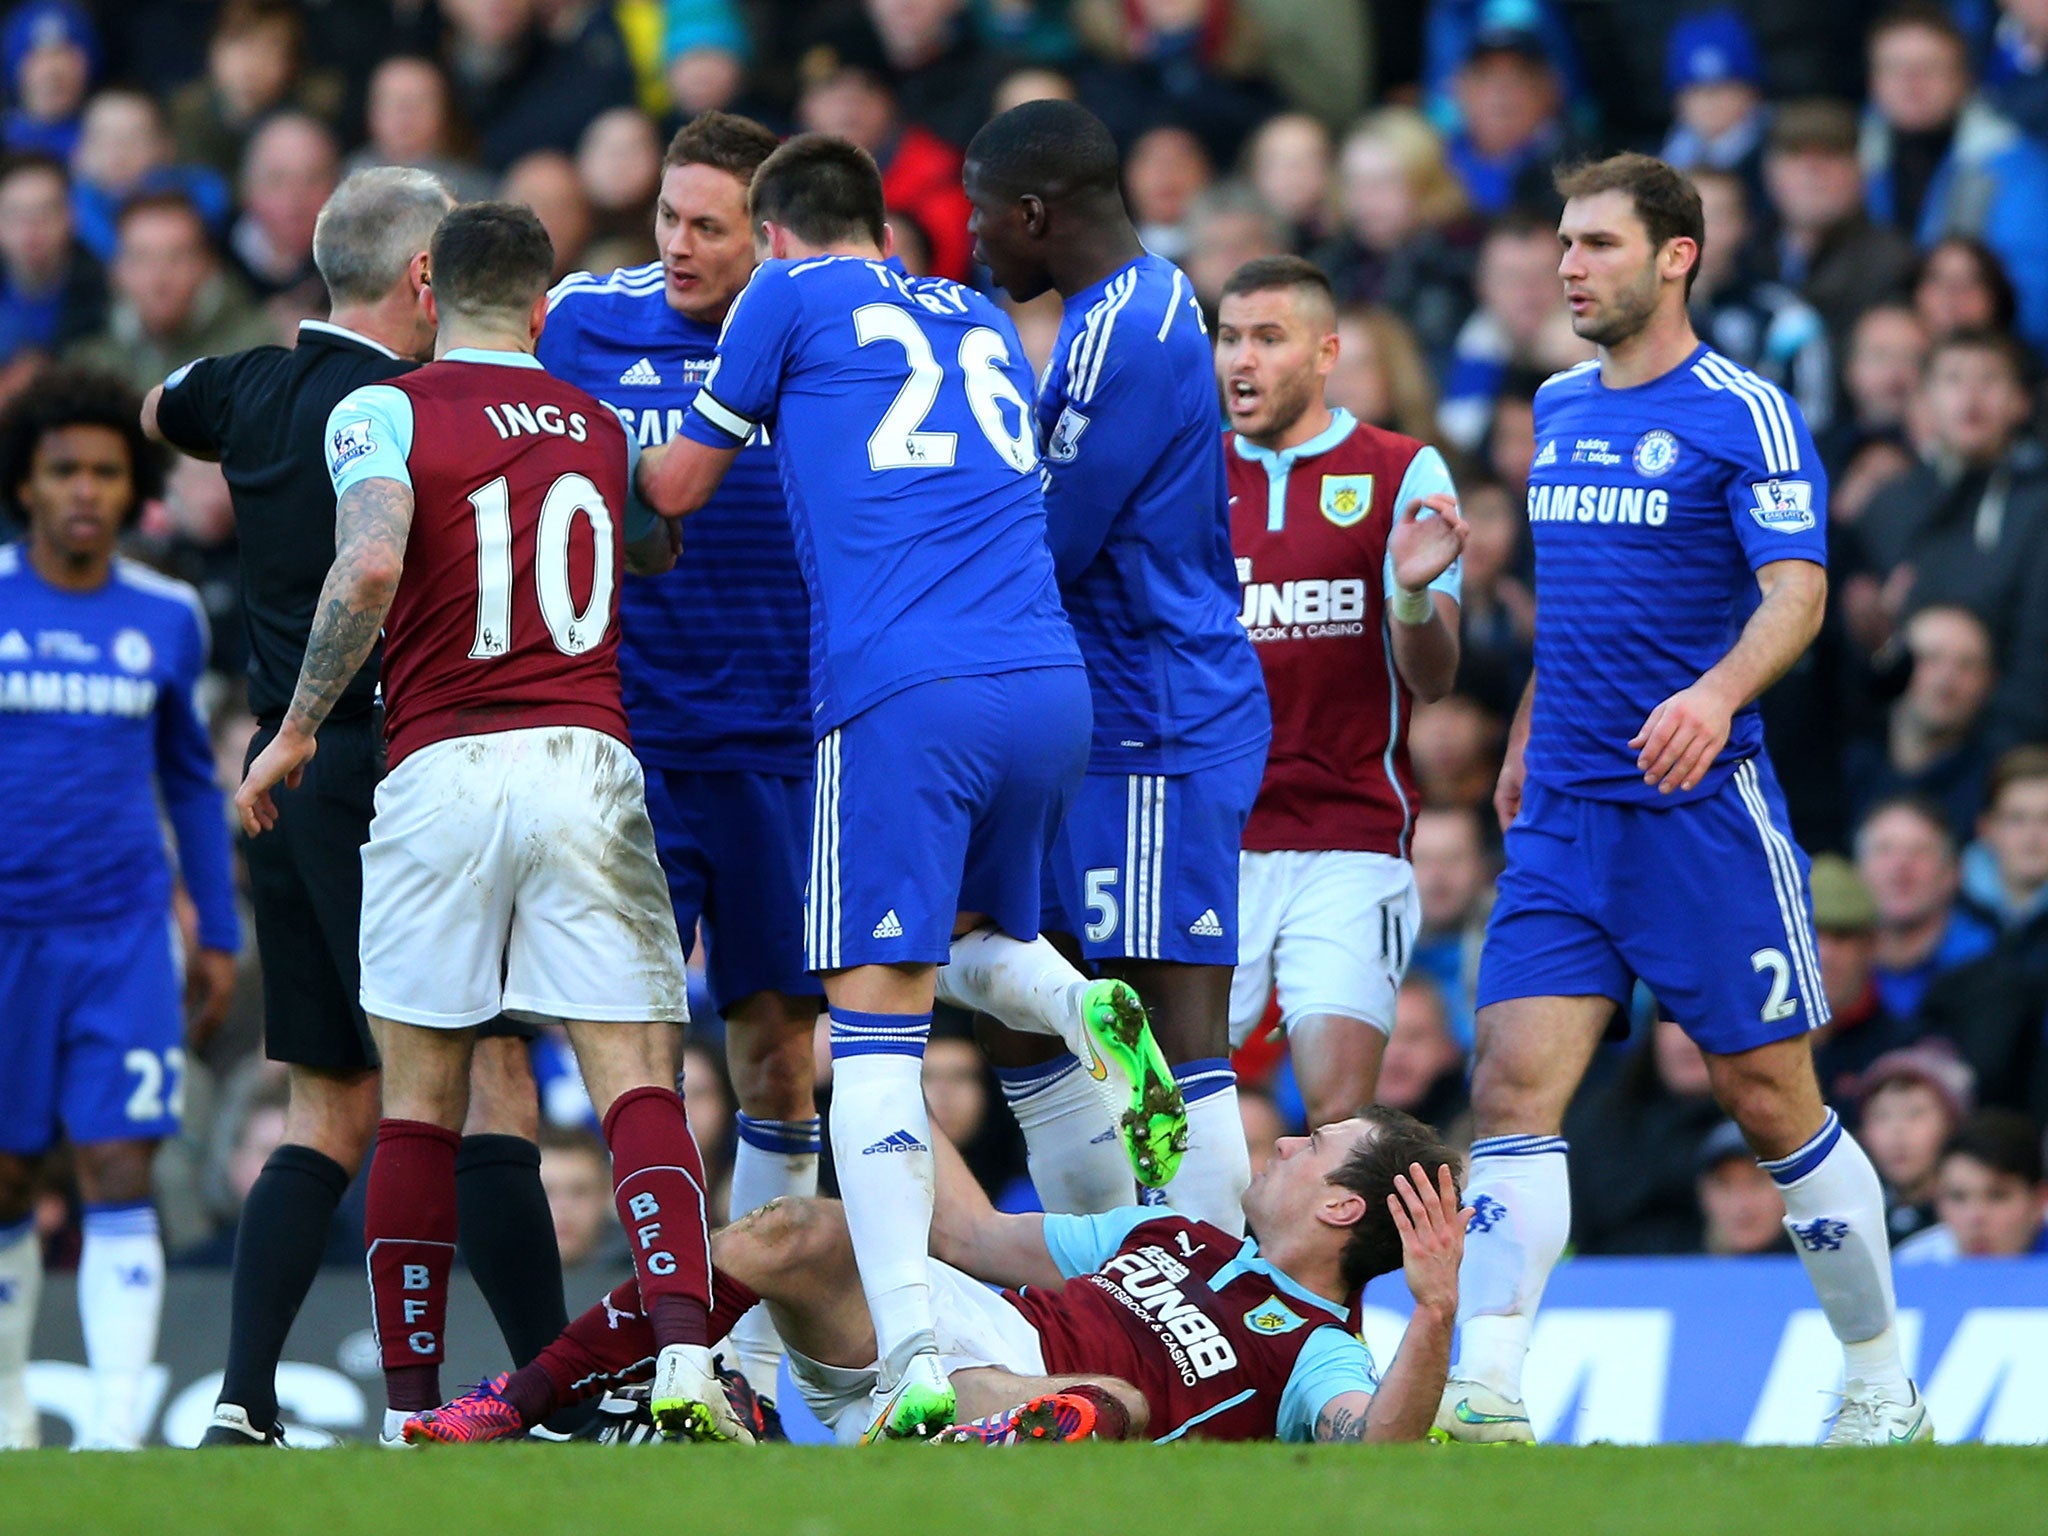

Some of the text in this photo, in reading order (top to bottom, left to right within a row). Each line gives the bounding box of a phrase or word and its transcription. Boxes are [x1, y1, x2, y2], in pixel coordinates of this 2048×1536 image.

[619, 374, 661, 385] adidas
[852, 302, 1038, 475] 26
[483, 402, 588, 442] INGS
[1528, 485, 1669, 526] SAMSUNG
[467, 472, 615, 659] 10
[1306, 622, 1363, 637] CASINO
[1084, 867, 1119, 943] 5
[872, 926, 903, 939] adidas
[1189, 925, 1223, 937] adidas
[1751, 947, 1797, 1023] 2
[862, 1142, 928, 1155] adidas
[1100, 1253, 1238, 1379] FUN88
[1160, 1332, 1197, 1387] CASINO
